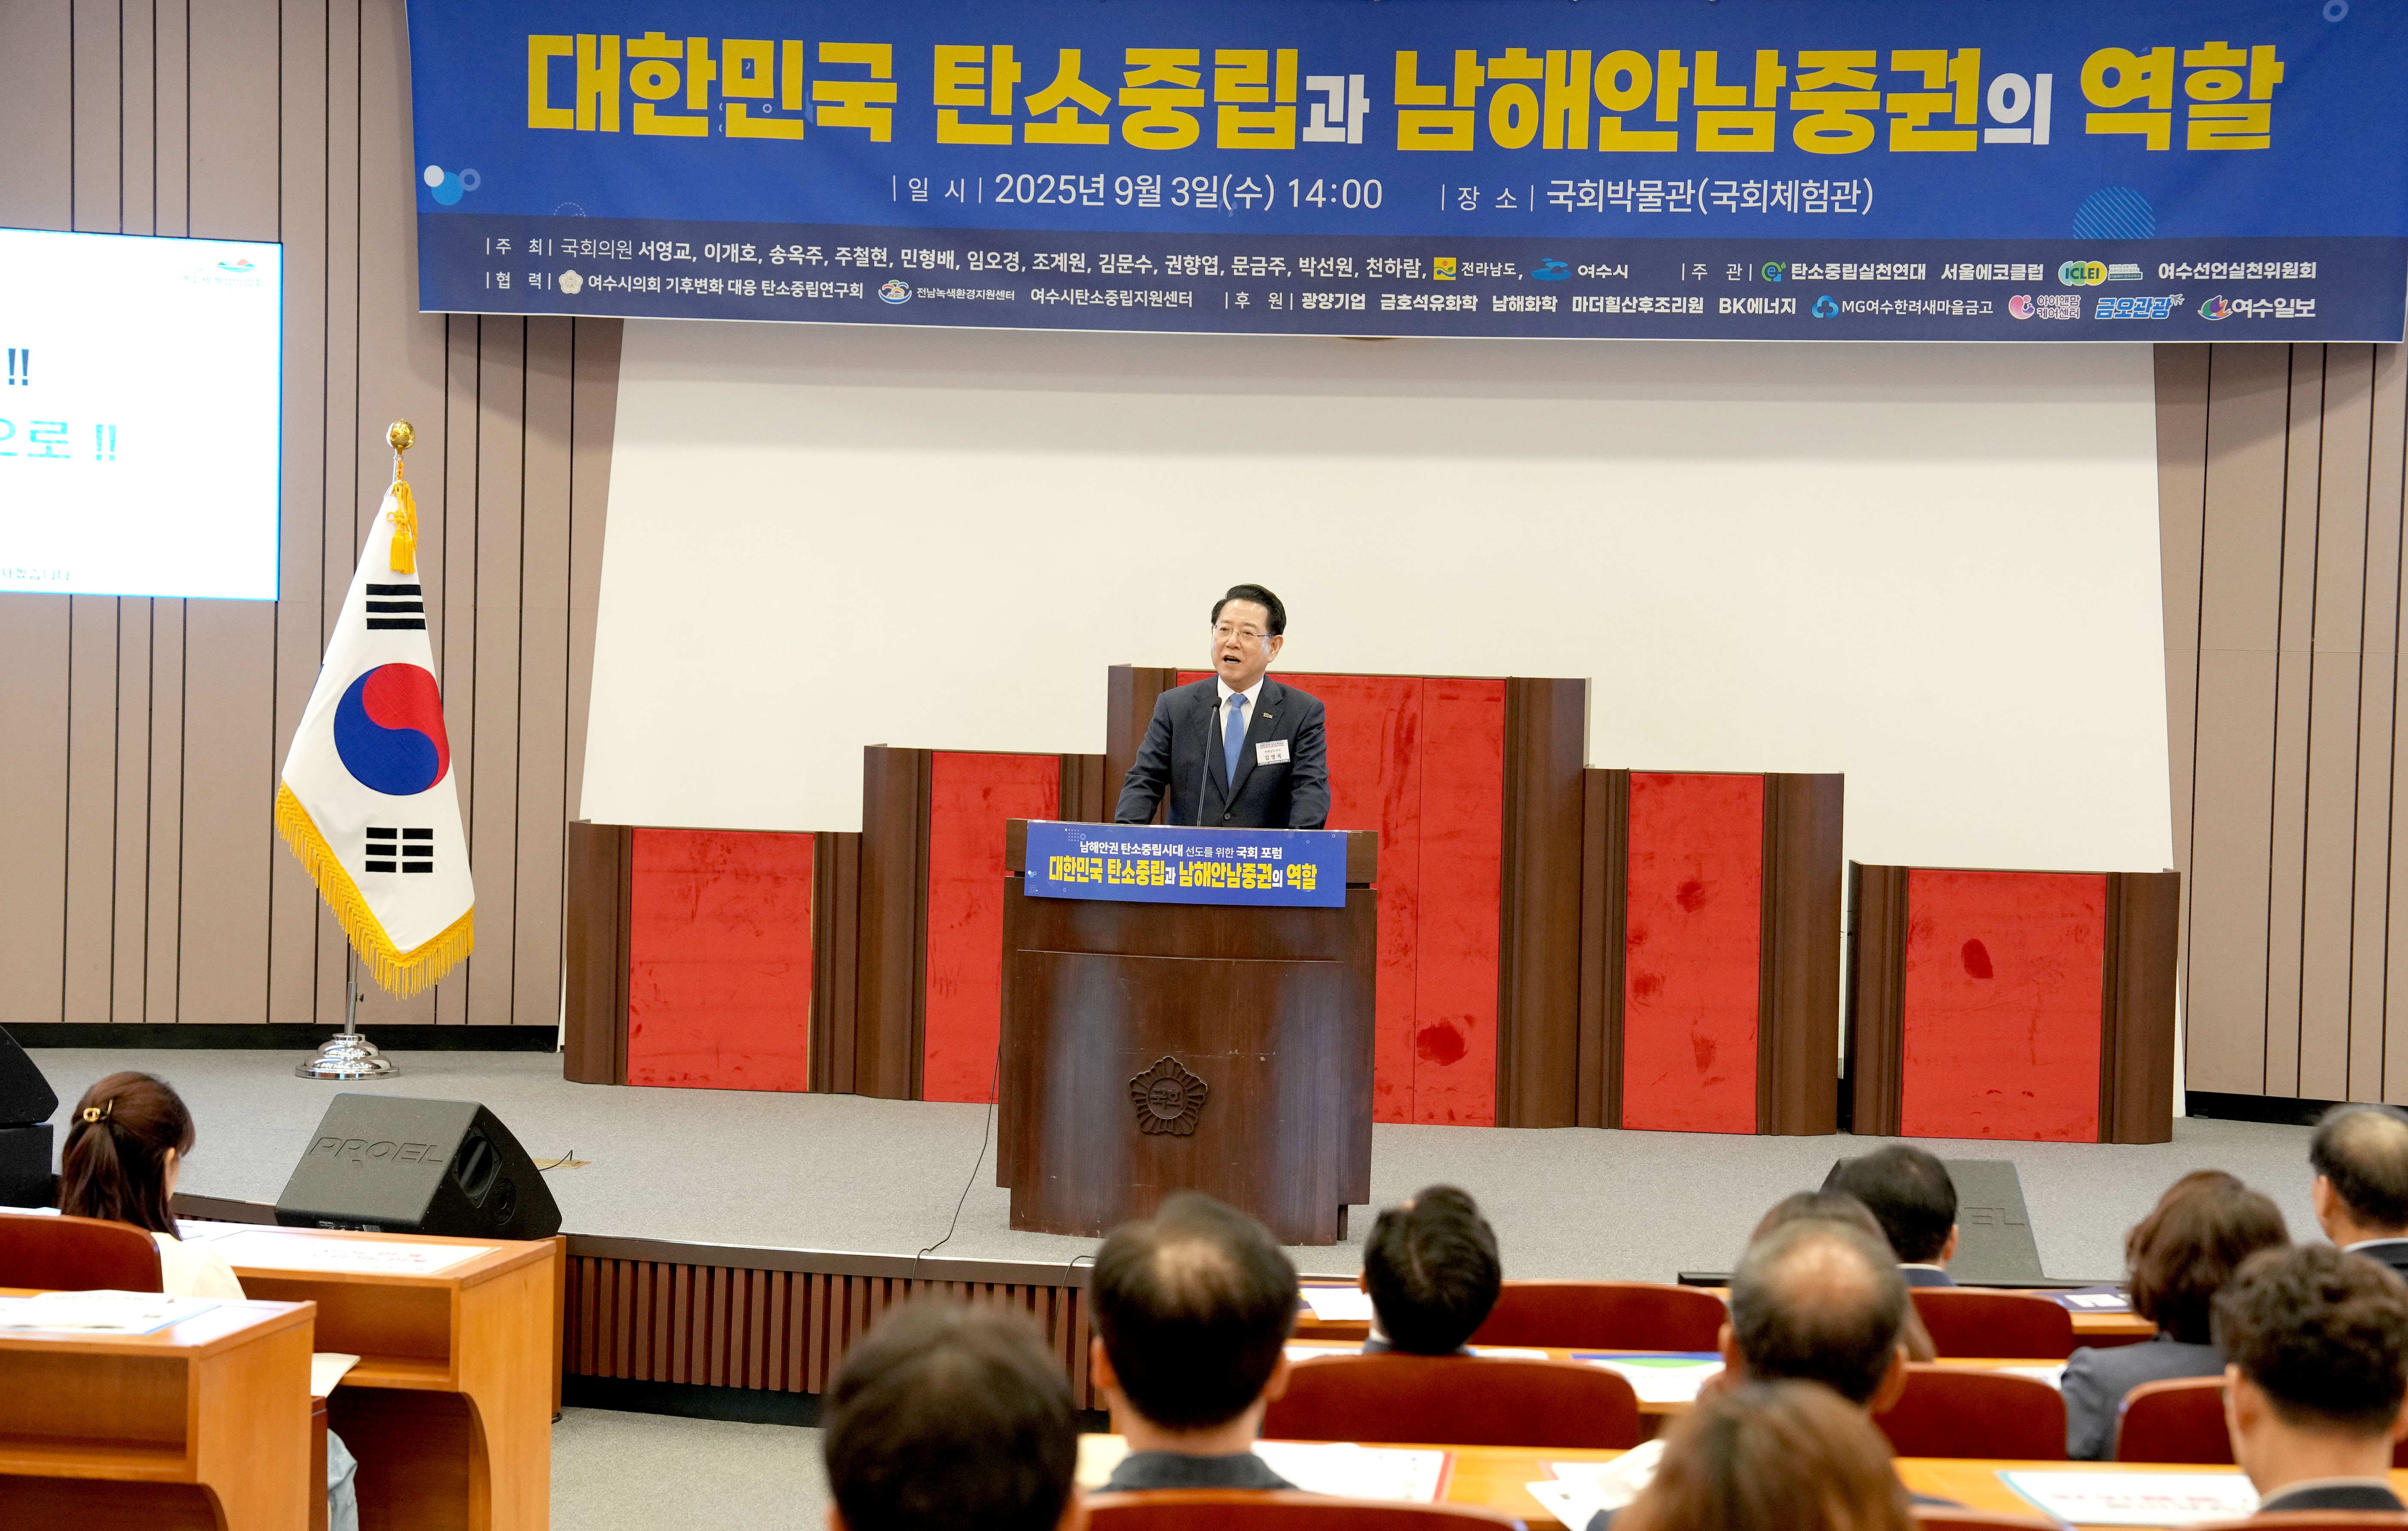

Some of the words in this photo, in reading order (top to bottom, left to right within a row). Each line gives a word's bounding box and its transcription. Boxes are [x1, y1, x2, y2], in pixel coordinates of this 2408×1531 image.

[529, 32, 897, 142] 대한민국
[934, 45, 1369, 150] 탄소중립과
[1395, 48, 2052, 154] 남해안남중권의
[2081, 42, 2284, 150] 역할
[909, 178, 927, 201] 일
[945, 179, 964, 202] 시
[996, 174, 1104, 205] 2025년
[1115, 175, 1161, 207] 9월
[1171, 174, 1274, 211] 3일(수)
[1289, 179, 1382, 208] 14:00
[1458, 186, 1480, 210] 장
[1496, 188, 1517, 208] 소
[1547, 178, 1872, 215] 국회박물관(국회체험관)
[496, 239, 511, 254] 주
[529, 239, 542, 255] 최
[561, 239, 632, 259] 국회의원
[638, 241, 696, 262] 서영교,
[705, 243, 762, 264] 이개호,
[769, 245, 828, 266] 송옥주,
[835, 247, 893, 268] 주철현,
[901, 249, 960, 270] 민형배,
[968, 251, 1026, 272] 임오경,
[1032, 253, 1091, 273] 조계원,
[1099, 254, 1158, 274] 김문수,
[1165, 255, 1224, 276] 권향엽,
[1231, 256, 1291, 277] 문금주,
[1299, 257, 1358, 278] 박선원,
[1366, 258, 1426, 279] 천하람,
[1578, 265, 1628, 278] 여수시
[1692, 264, 1707, 280] 주
[1726, 263, 1743, 280] 관
[1792, 263, 1926, 280] 탄소중립실천연대
[1941, 264, 2043, 280] 서울에코클럽
[2065, 268, 2099, 279] ICLEI
[2158, 262, 2316, 279] 여수선언실천위원회
[496, 272, 509, 289] 협
[529, 273, 541, 289] 력
[589, 275, 660, 292] 여수시의회
[666, 277, 724, 294] 기후변화
[728, 279, 757, 296] 대응
[762, 280, 863, 298] 탄소중립연구회
[917, 288, 1014, 300] 전남녹색환경지원센터
[1031, 288, 1192, 307] 여수시탄소중립지원센터
[1235, 292, 1250, 309] 후
[1268, 292, 1282, 309] 원
[1302, 293, 1365, 310] 광양기업
[1381, 294, 1478, 311] 금호석유화학
[2037, 295, 2081, 307] 아이앤맘
[1493, 295, 1558, 312] 남해화학
[1572, 296, 1703, 313] 마더힐산후조리원
[1719, 298, 1796, 314] BK에너지
[1842, 300, 1993, 315] MG여수한려새마을금고
[2095, 297, 2172, 319] 금오관광
[2232, 298, 2315, 318] 여수일보
[2037, 307, 2080, 319] 케어센터
[1080, 841, 1118, 854] 남해안권
[1121, 843, 1183, 857] 탄소중립시대
[1185, 846, 1213, 857] 선도를
[1215, 847, 1234, 858] 위한
[1236, 847, 1258, 859] 국회
[1260, 847, 1282, 859] 포럼
[1049, 855, 1103, 883] 대한민국
[1108, 858, 1176, 886] 탄소중립과
[1179, 861, 1283, 889] 남해안남중권의
[1287, 863, 1317, 890] 역할
[309, 1137, 443, 1167] PROEL
